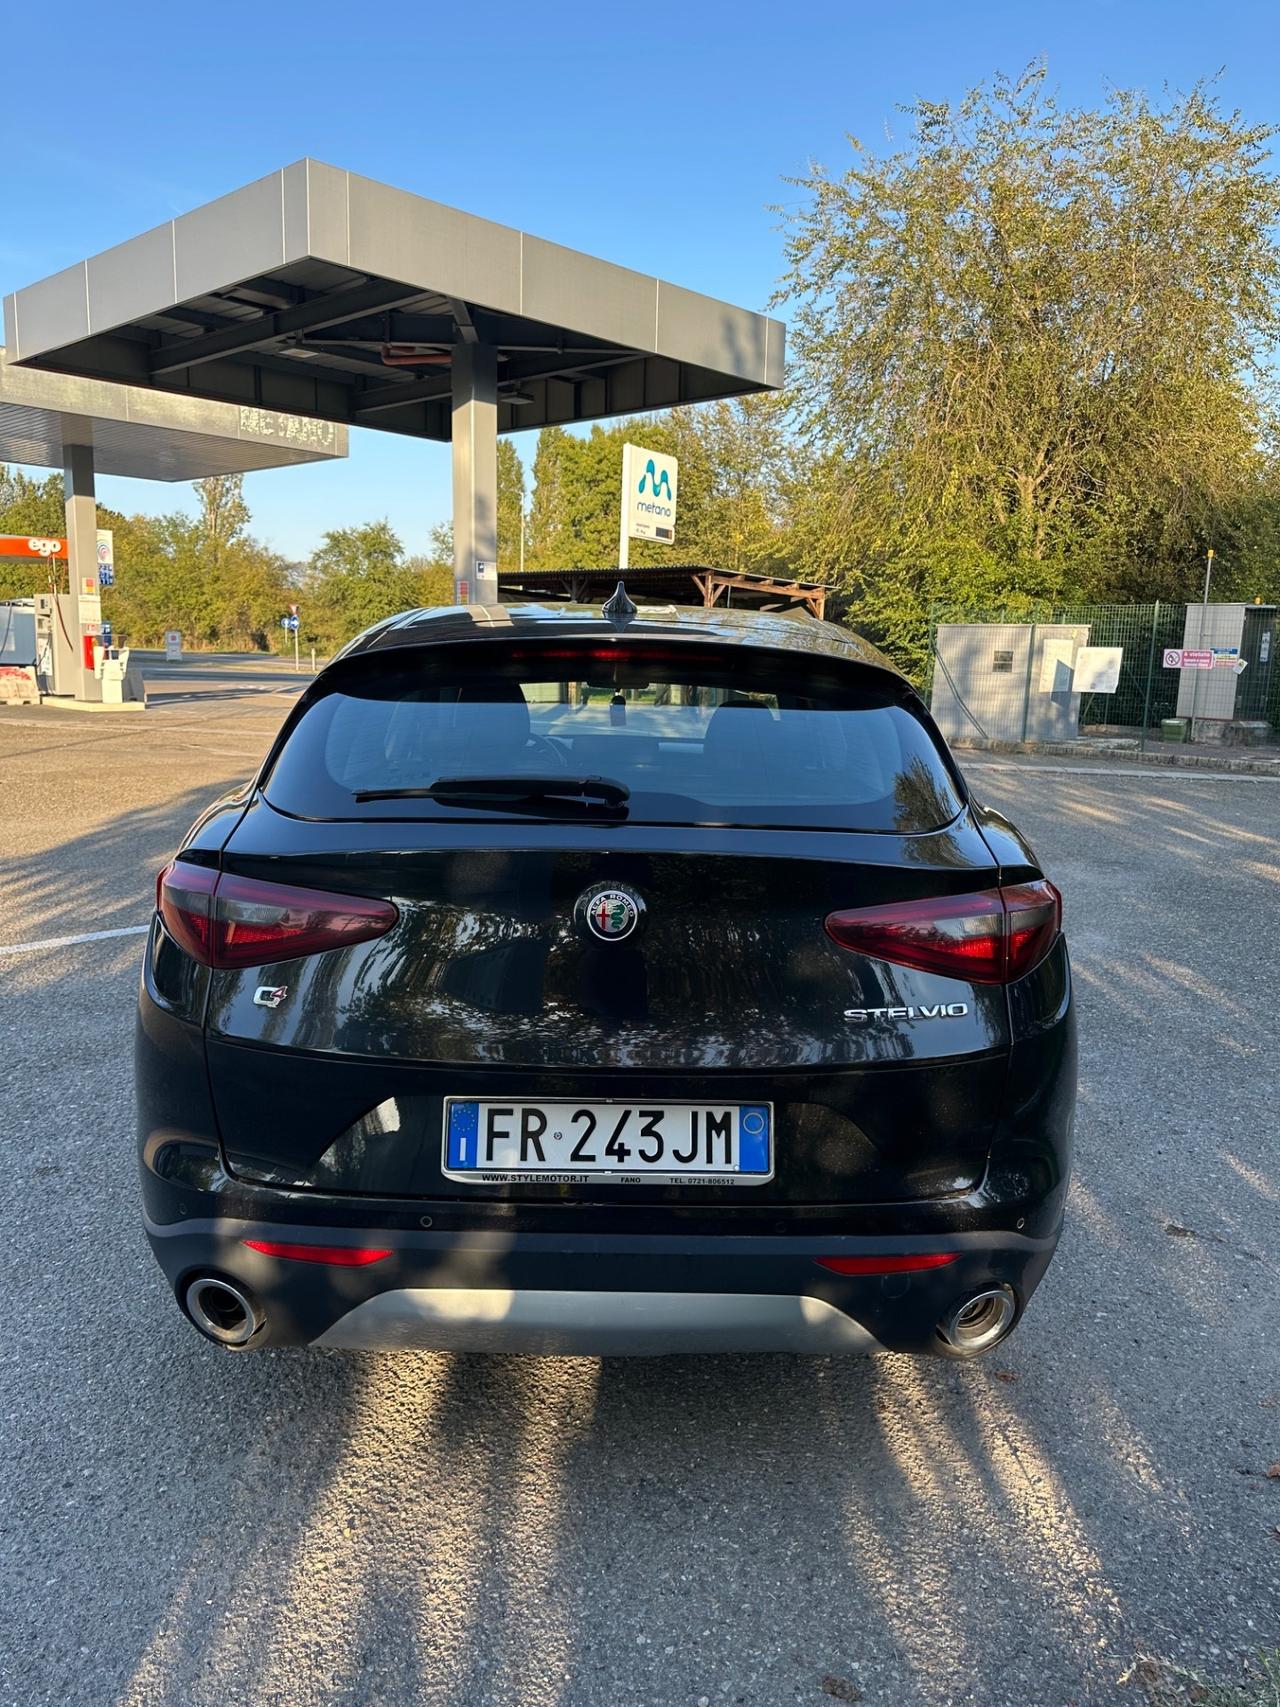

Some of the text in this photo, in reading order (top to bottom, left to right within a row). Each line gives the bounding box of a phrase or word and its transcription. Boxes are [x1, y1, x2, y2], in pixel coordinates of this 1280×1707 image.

[637, 501, 672, 517] metano
[591, 894, 634, 917] ALFA ROMEO
[843, 1003, 969, 1022] STELVIO
[486, 1108, 547, 1162] FR
[482, 1174, 590, 1183] WWW.STYLEMOTOR.IT
